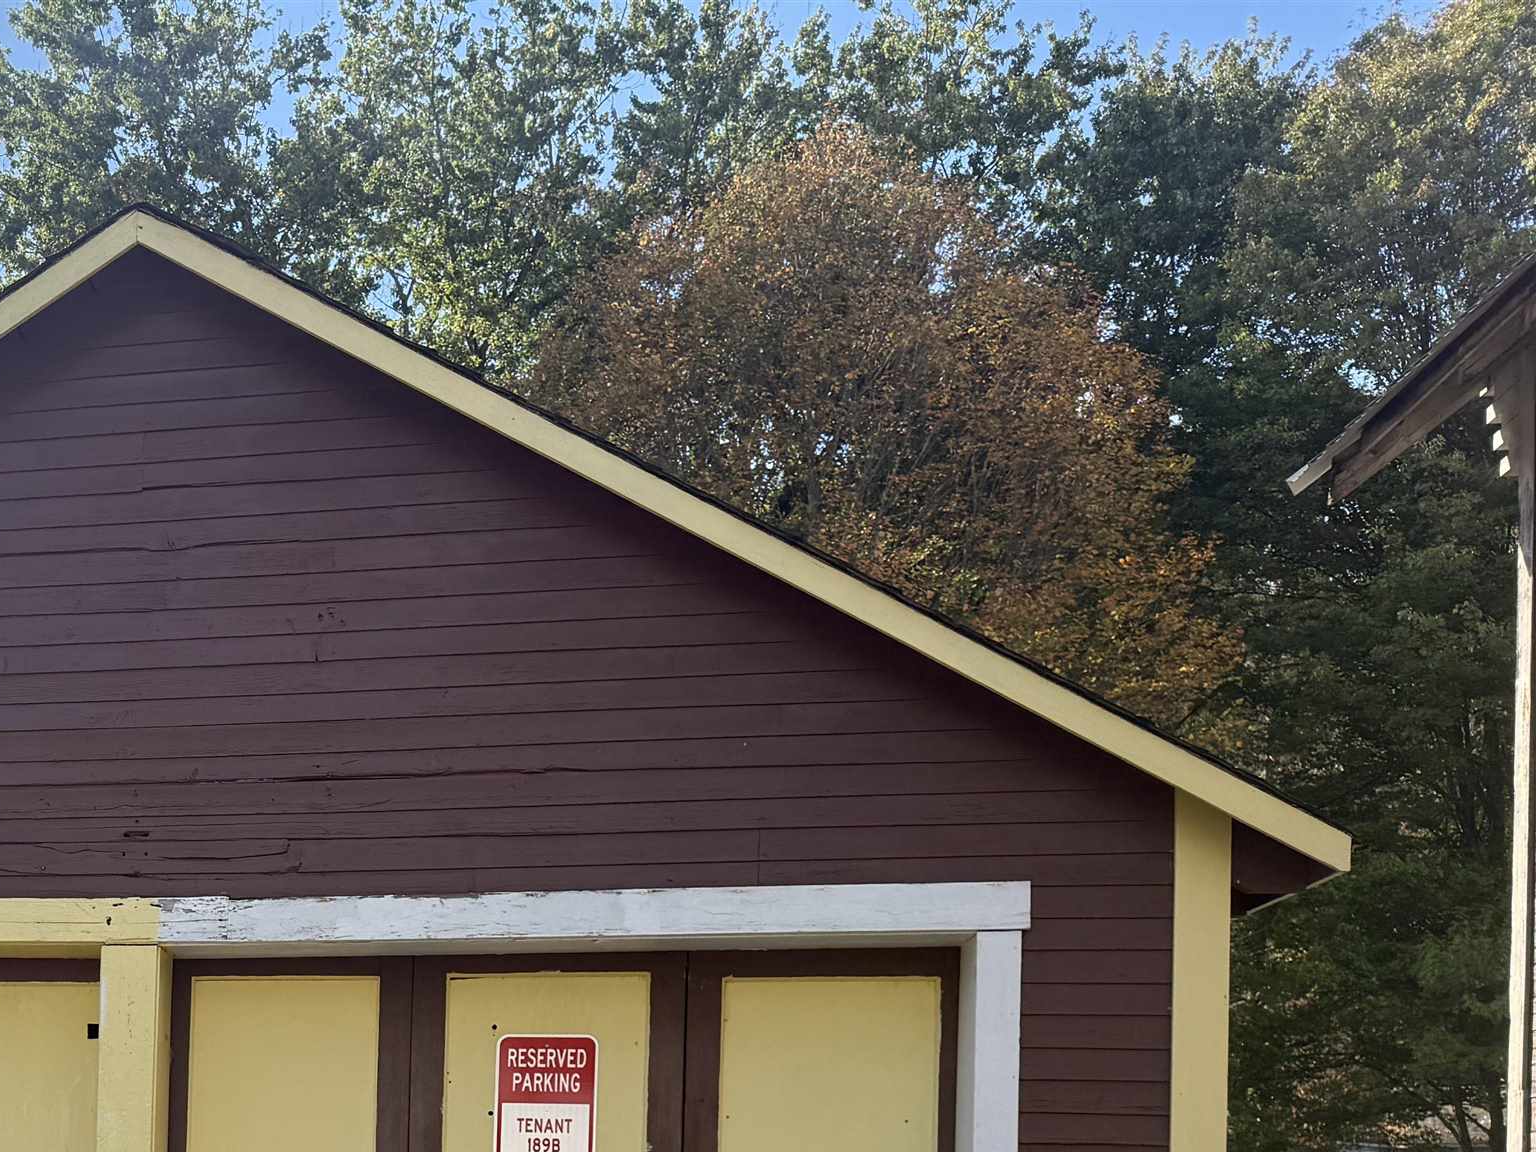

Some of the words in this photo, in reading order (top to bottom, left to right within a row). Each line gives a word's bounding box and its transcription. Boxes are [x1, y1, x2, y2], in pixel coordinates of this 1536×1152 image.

[507, 1048, 587, 1068] RESERVED
[512, 1072, 581, 1093] PARKING
[517, 1118, 572, 1134] TENANT
[527, 1138, 561, 1152] 189B
